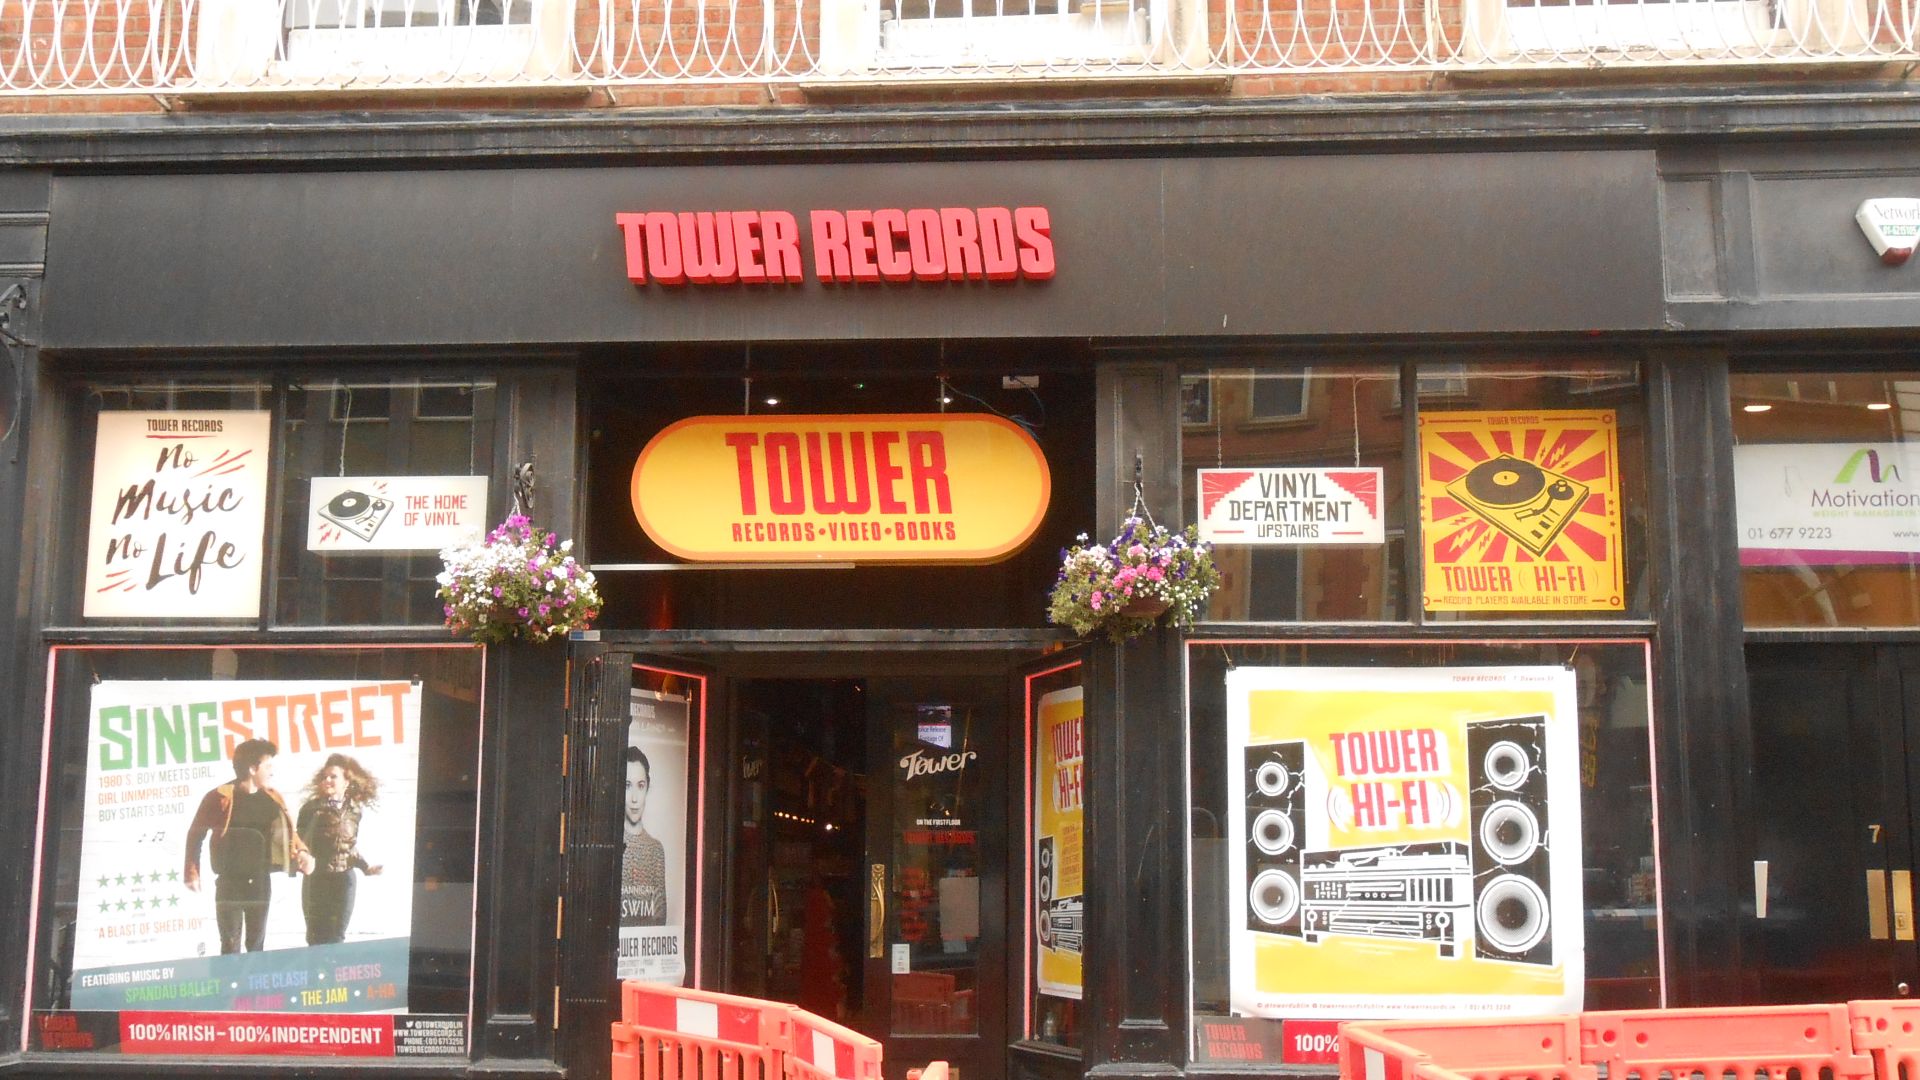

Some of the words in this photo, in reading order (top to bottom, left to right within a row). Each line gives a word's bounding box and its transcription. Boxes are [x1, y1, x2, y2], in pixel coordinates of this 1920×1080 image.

[615, 210, 803, 285] TOWER
[810, 206, 1055, 284] RECORDS
[146, 418, 180, 432] TOWER
[181, 419, 225, 433] RECORDS
[725, 430, 953, 516] TOWER
[1259, 472, 1327, 499] VINYL
[111, 478, 244, 525] Music
[405, 495, 430, 510] THE
[434, 495, 469, 510] HOME
[1811, 488, 1920, 508] Motivation
[404, 512, 420, 526] OF
[424, 511, 460, 526] VINYL
[1229, 500, 1352, 523] DEPARTMENT
[1257, 524, 1320, 539] UPSTAIRS
[1748, 527, 1764, 540] 01
[1769, 527, 1794, 539] 677
[1799, 527, 1833, 540] 9223
[145, 530, 247, 596] Life
[1441, 566, 1513, 592] TOWER
[1534, 566, 1586, 592] HI-FI
[1443, 595, 1472, 606] RECORD
[1475, 595, 1510, 606] PLAYERS
[1511, 595, 1550, 605] AVAILABLE
[1552, 595, 1562, 605] IN
[1562, 595, 1588, 605] STORE
[1328, 727, 1440, 777] TOWER
[899, 749, 977, 780] Tower
[137, 772, 156, 785] BOY
[158, 768, 190, 782] MEETS
[98, 792, 118, 805] GIRL
[1351, 779, 1431, 828] HI-FI
[98, 810, 117, 822] BOY
[119, 804, 155, 820] STARTS
[158, 802, 185, 815] BAND
[1868, 824, 1881, 844] 7
[621, 899, 656, 918] SWIM
[107, 923, 136, 938] BLAST
[139, 922, 151, 935] OF
[153, 918, 185, 934] SHEER
[617, 936, 640, 957] WER
[641, 935, 679, 956] RECORDS
[82, 972, 131, 987] FEATURING
[131, 969, 161, 983] MUSIC
[162, 967, 176, 980] BY
[126, 984, 176, 1003] SPANDAU
[179, 978, 221, 998] BALLET
[248, 974, 270, 990] THE
[272, 970, 308, 987] CLASH
[335, 963, 381, 982] GENESIS
[301, 990, 323, 1006] THE
[324, 987, 348, 1004] JAM
[128, 1023, 170, 1042] 100%
[172, 1025, 215, 1042] IRISH
[228, 1026, 270, 1043] 100%
[272, 1027, 383, 1045] INDEPENDENT
[1203, 1023, 1248, 1042] TOWER
[1208, 1041, 1265, 1061] RECORDS
[1295, 1034, 1340, 1054] 100%
